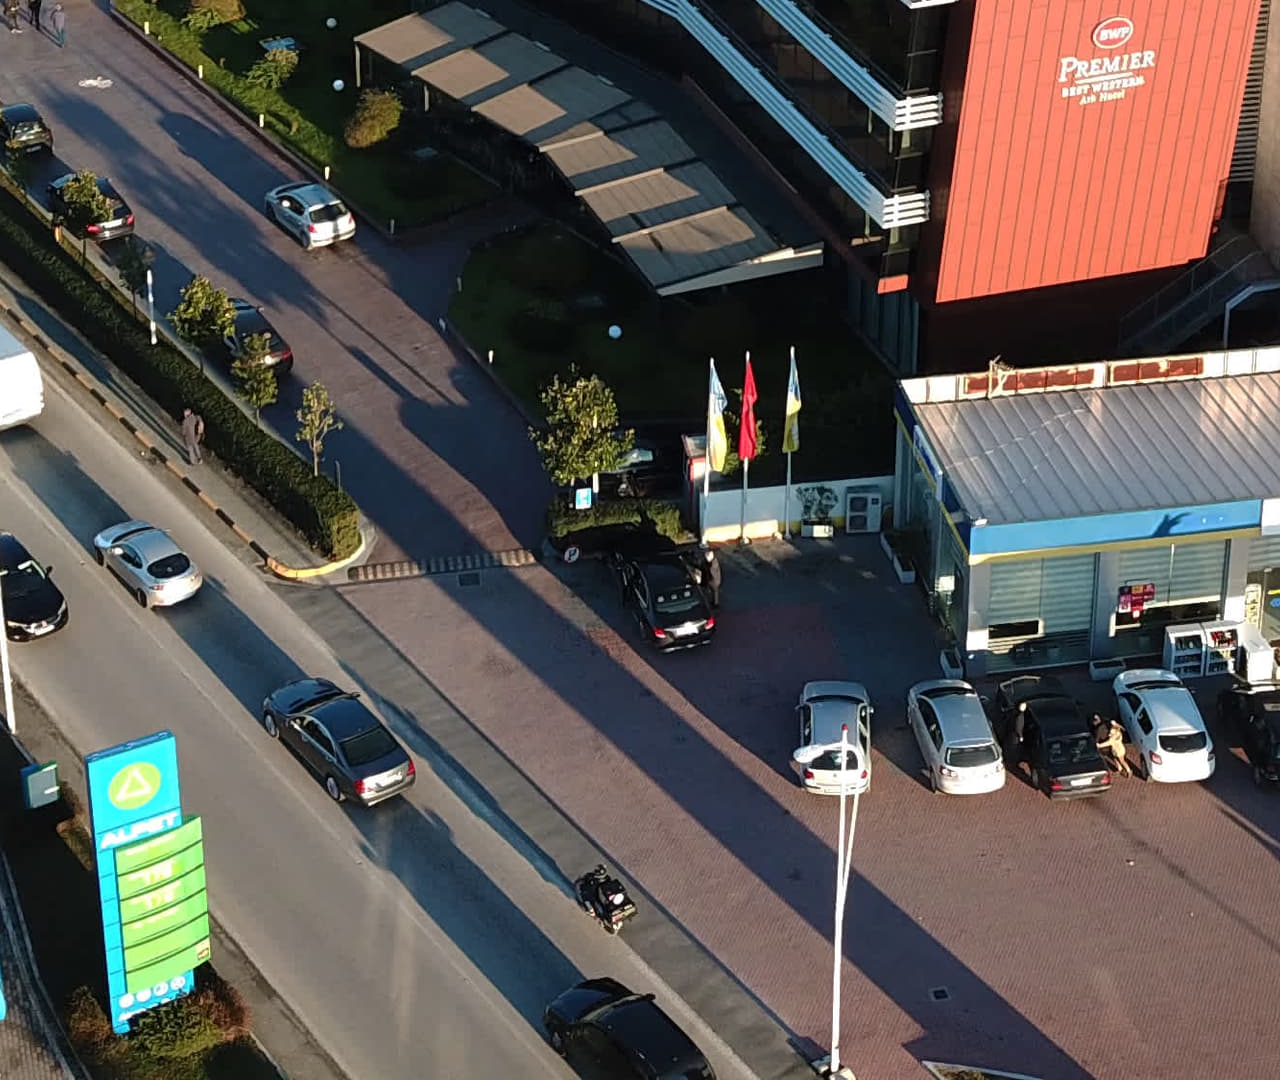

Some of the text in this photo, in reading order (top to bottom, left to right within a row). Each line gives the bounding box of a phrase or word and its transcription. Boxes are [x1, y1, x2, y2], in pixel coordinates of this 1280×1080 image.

[1099, 26, 1130, 42] BWP
[1058, 50, 1155, 82] PREMIER
[1061, 76, 1145, 98] BEST WESTERN
[100, 811, 179, 849] ALPET
